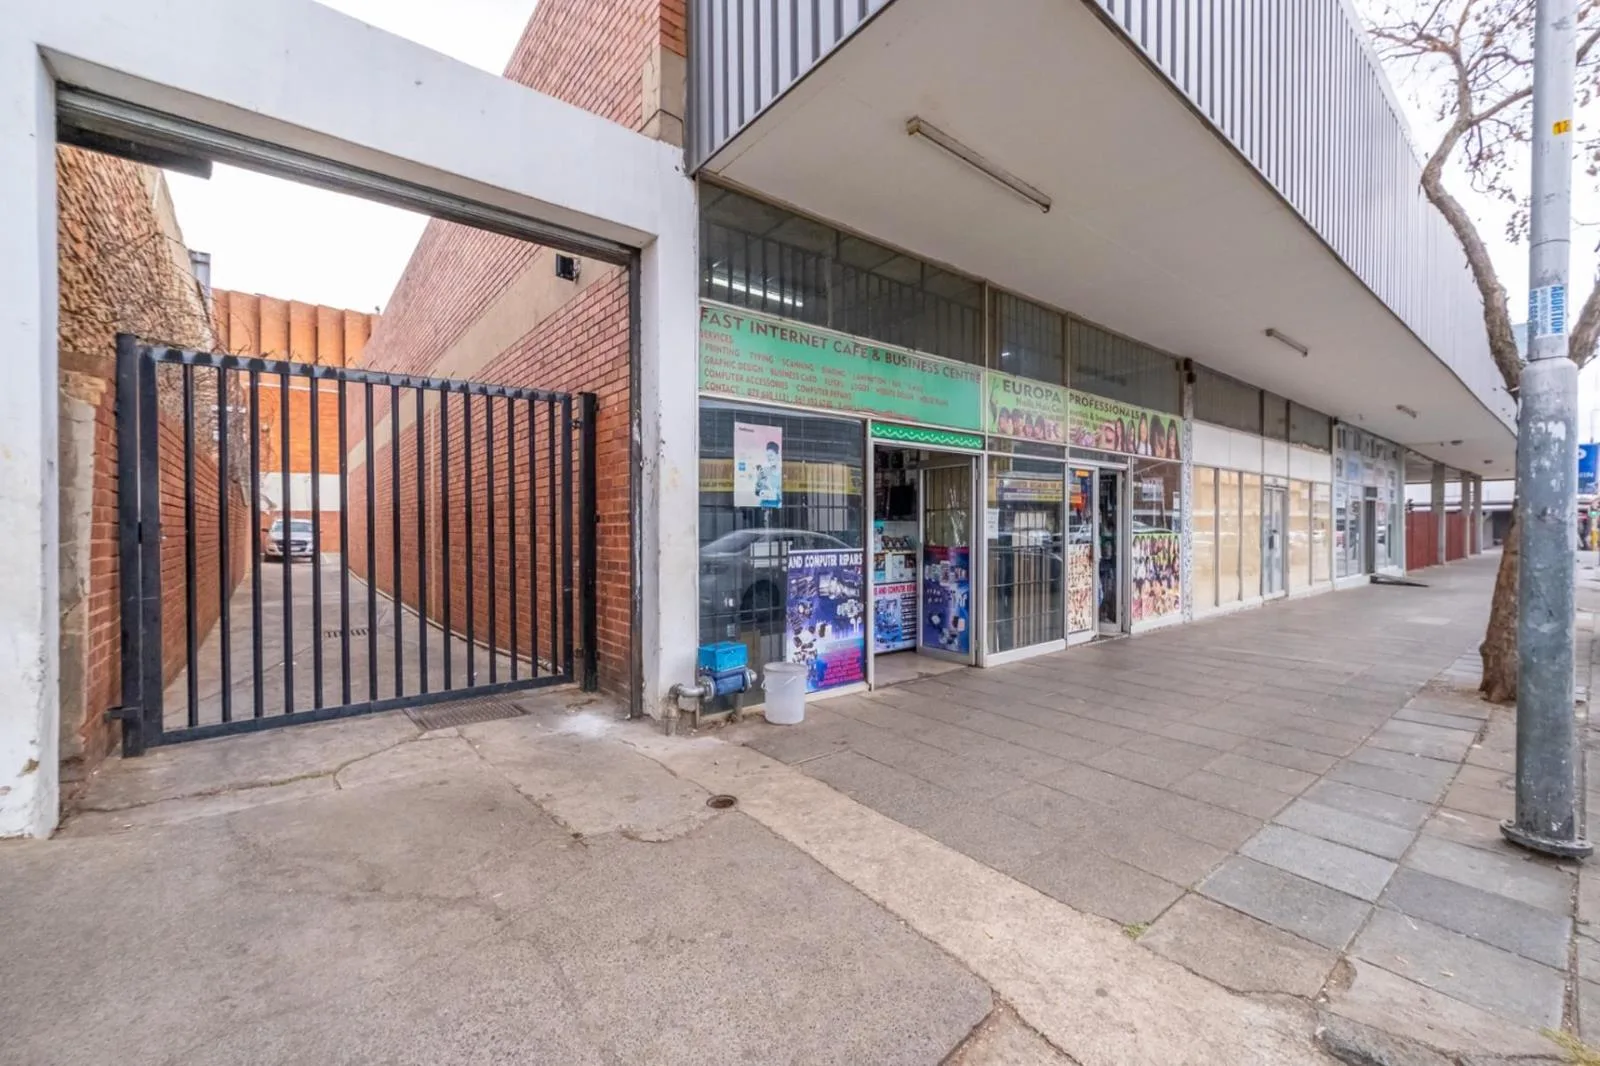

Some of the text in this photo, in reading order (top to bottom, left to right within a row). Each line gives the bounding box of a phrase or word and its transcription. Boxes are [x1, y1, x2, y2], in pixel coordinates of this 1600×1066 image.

[1551, 286, 1564, 334] ABORTION
[700, 306, 744, 331] FAST
[750, 321, 828, 350] INTERNET
[833, 341, 868, 360] CAFE
[871, 348, 881, 362] &
[884, 352, 940, 375] BUSINESS
[704, 367, 744, 382] COMPUTER
[1003, 380, 1062, 404] EUROPA
[1069, 393, 1140, 419] PROFESSIONALS
[788, 551, 863, 568] AND COMPUTER REPAIRS
